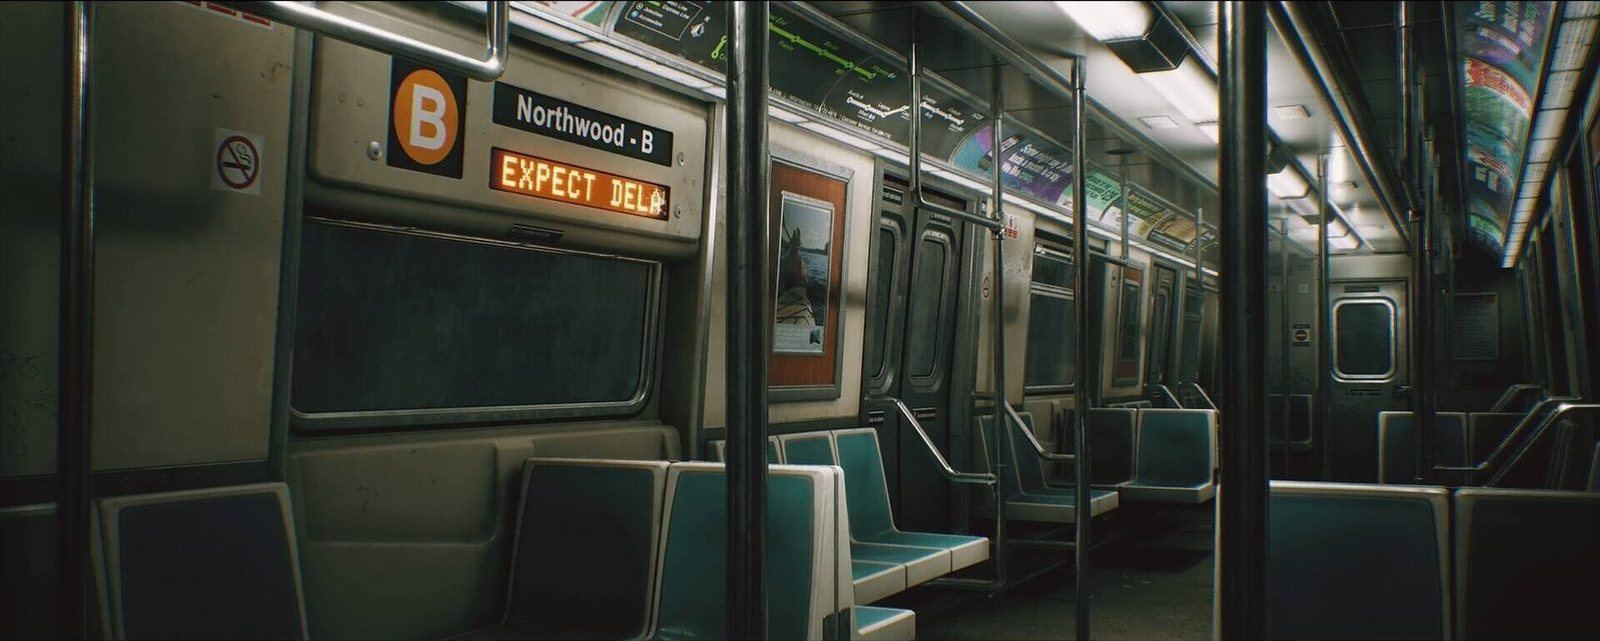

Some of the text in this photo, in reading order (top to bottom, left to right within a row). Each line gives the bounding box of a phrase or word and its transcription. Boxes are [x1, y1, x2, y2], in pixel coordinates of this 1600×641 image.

[409, 83, 447, 150] B
[517, 94, 625, 148] Northwood
[641, 129, 654, 154] B
[501, 154, 596, 202] EXPECT
